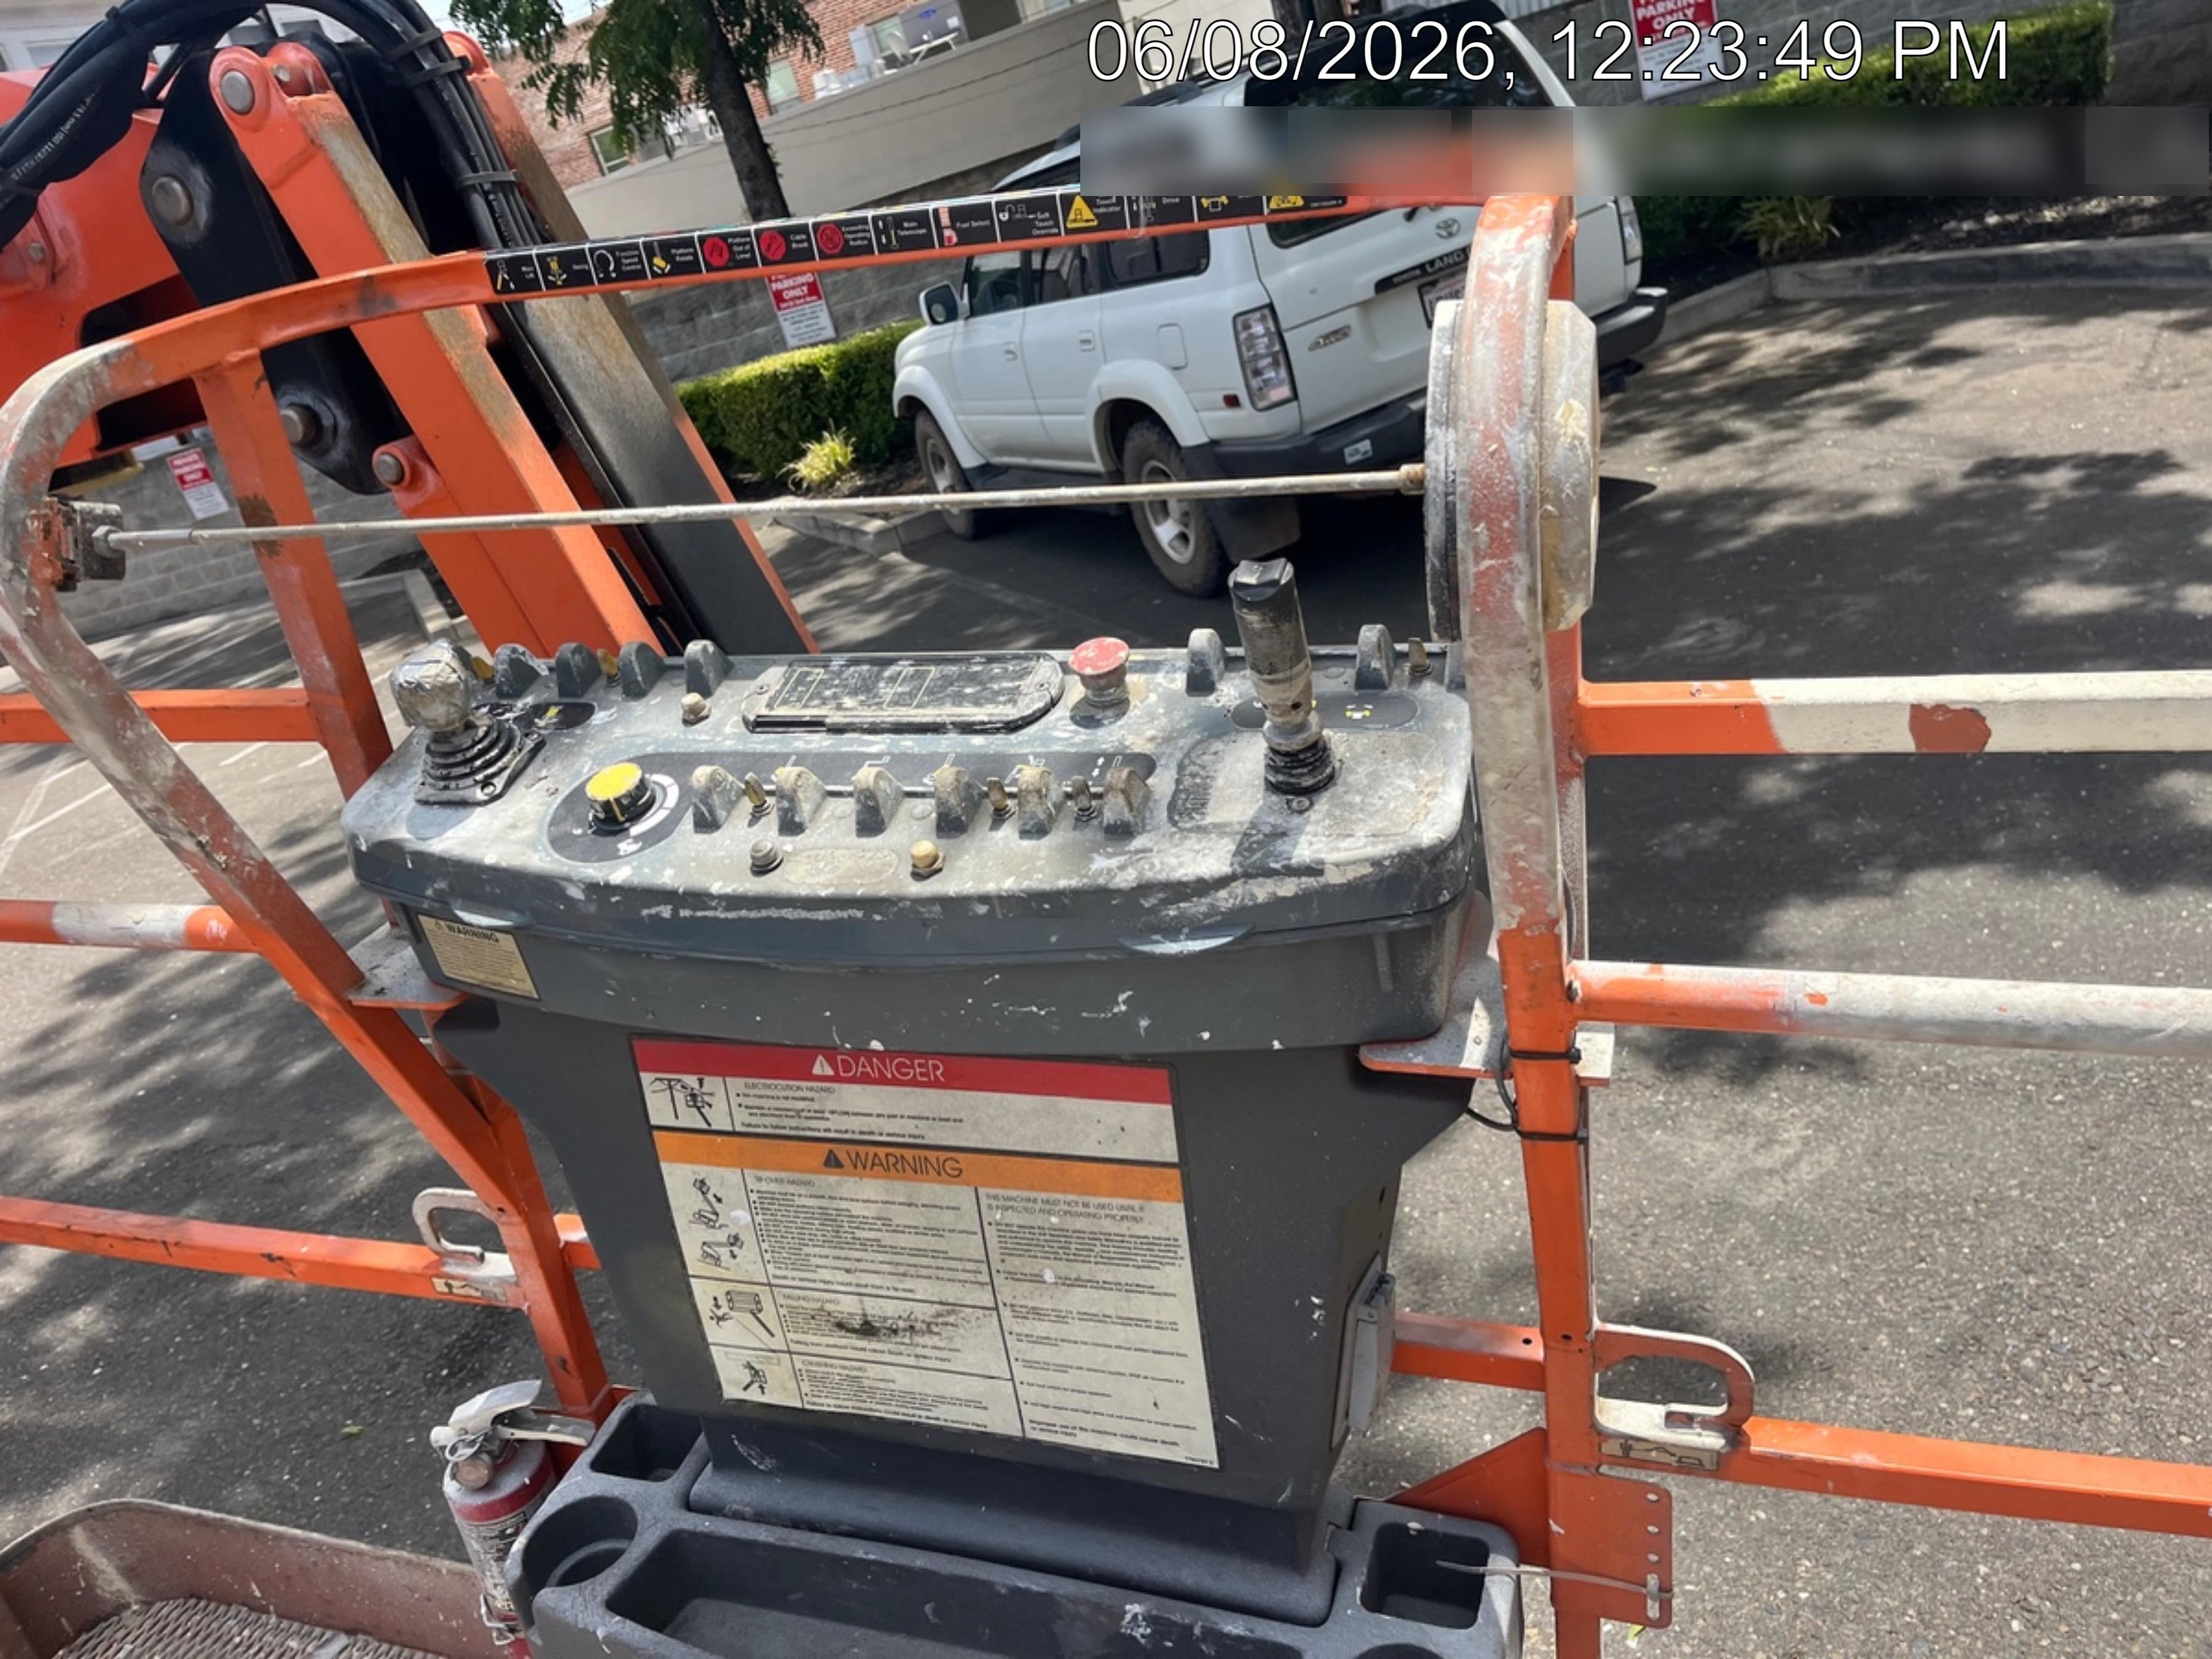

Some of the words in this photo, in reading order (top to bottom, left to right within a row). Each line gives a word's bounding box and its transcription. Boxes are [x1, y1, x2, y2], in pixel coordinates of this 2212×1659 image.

[1426, 249, 1464, 272] LAND
[836, 1054, 945, 1082] DANGER
[845, 1149, 963, 1179] WARNING
